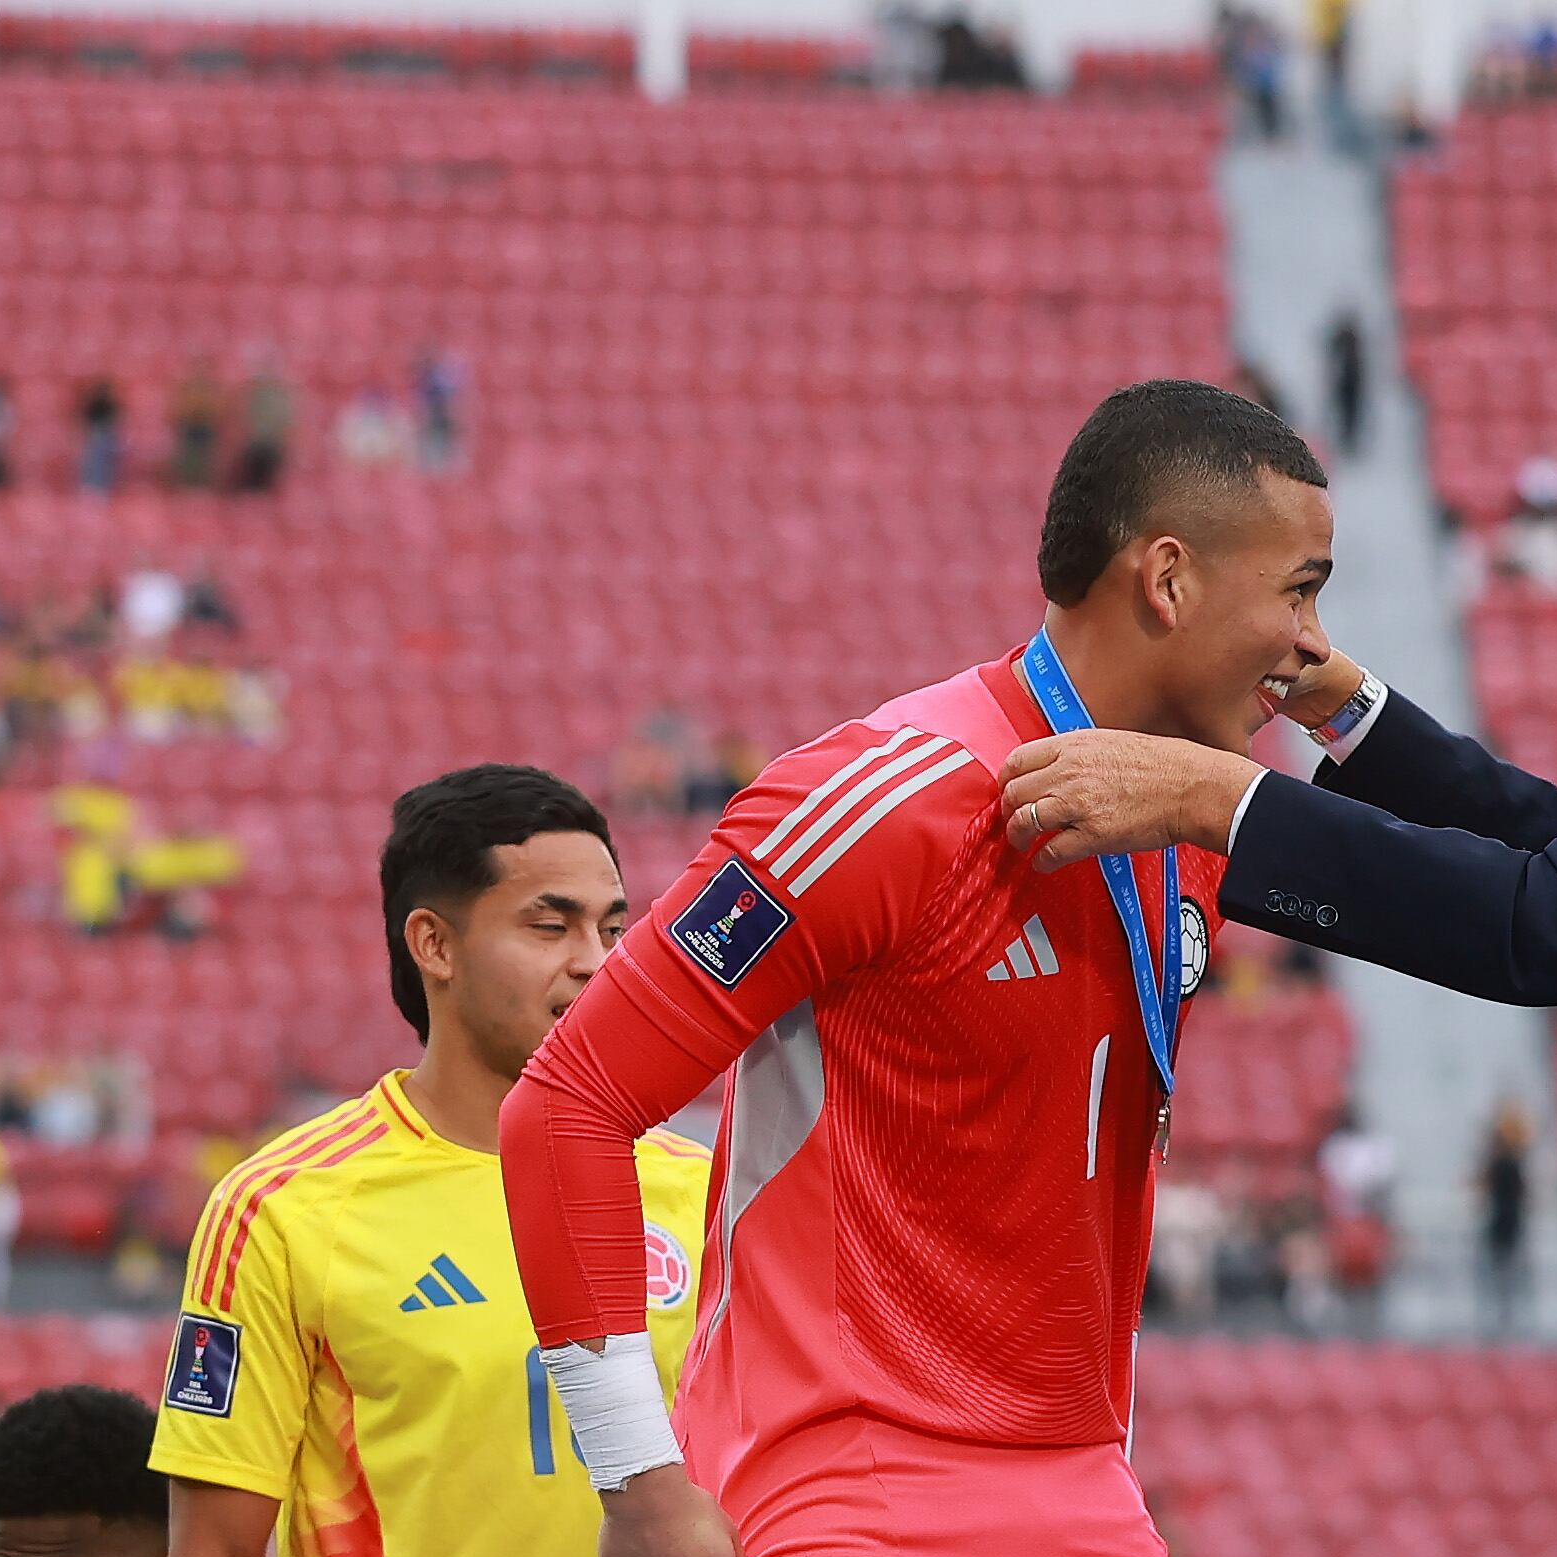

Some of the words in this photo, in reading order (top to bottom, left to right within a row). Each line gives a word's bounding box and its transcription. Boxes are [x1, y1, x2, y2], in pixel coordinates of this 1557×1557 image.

[1048, 685, 1069, 713] FIFA
[685, 931, 706, 953] CHILE
[703, 950, 725, 969] 2025
[704, 931, 720, 949] FIFA
[1086, 1034, 1110, 1180] 1
